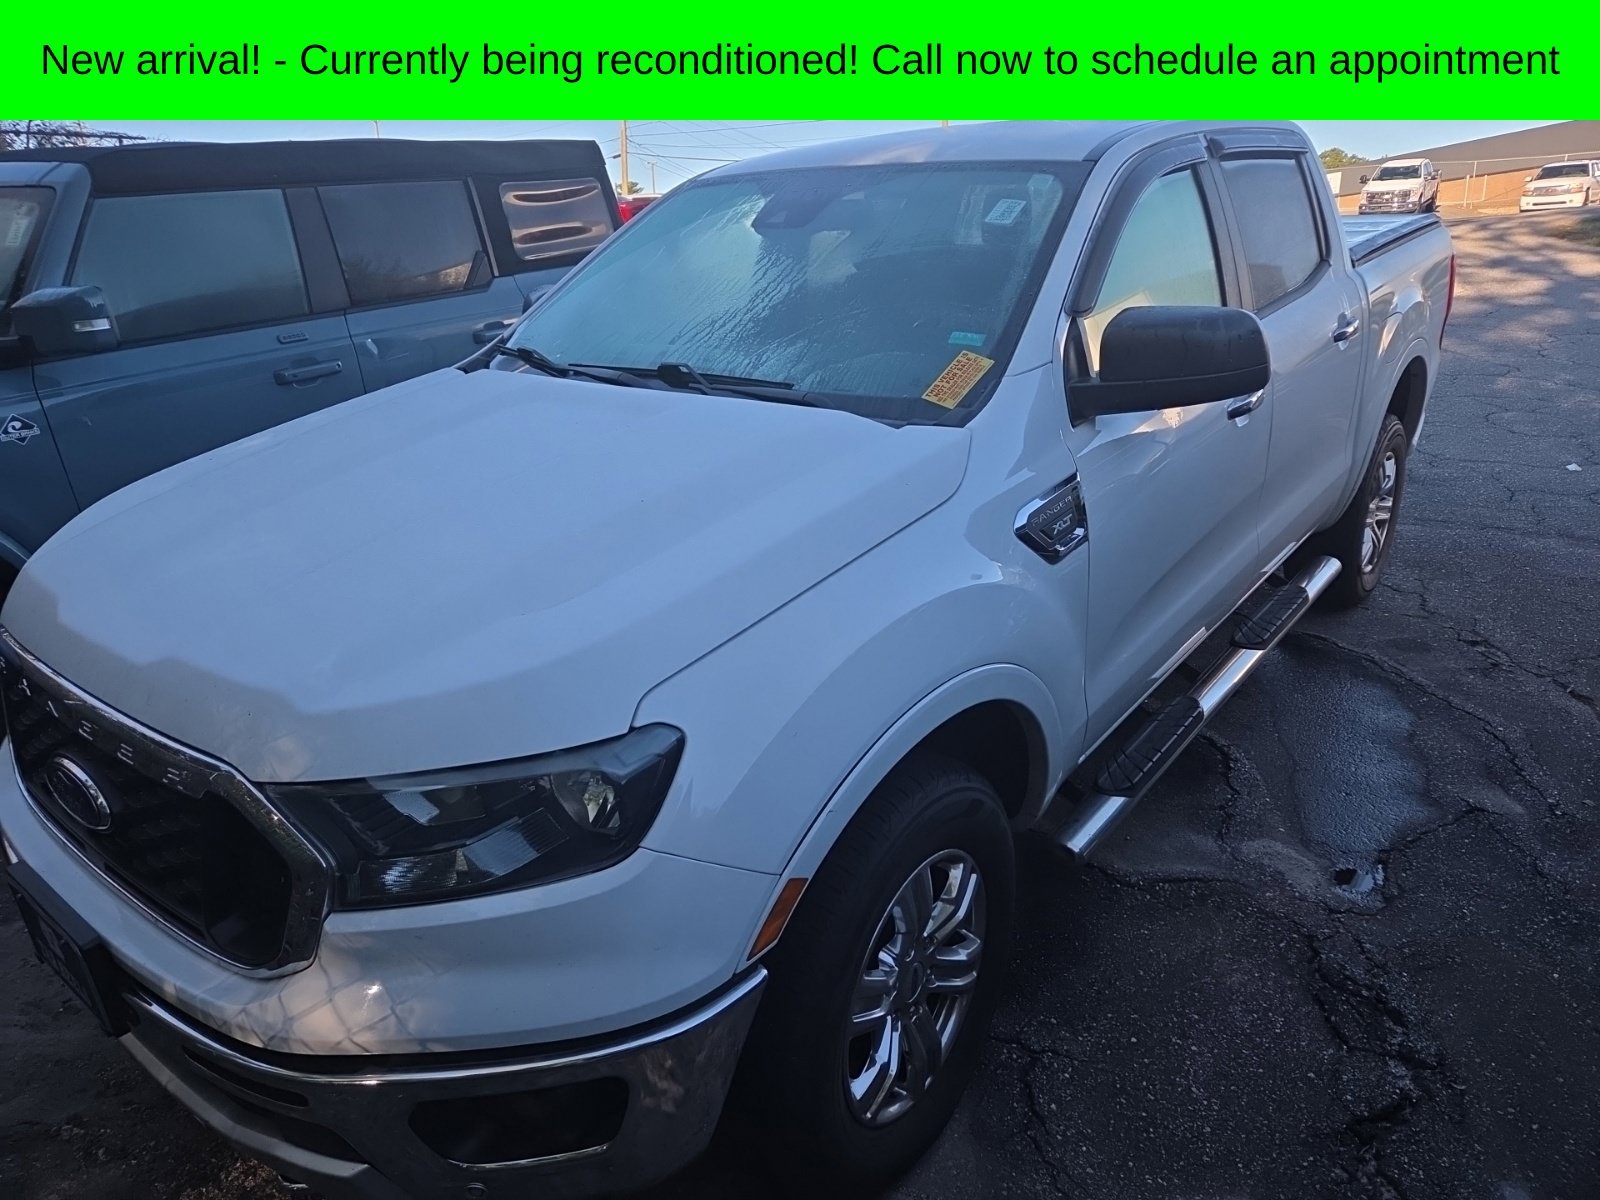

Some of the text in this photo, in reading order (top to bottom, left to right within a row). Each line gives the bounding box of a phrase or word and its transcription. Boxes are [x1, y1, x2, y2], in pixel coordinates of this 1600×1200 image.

[925, 383, 941, 397] THIS
[938, 358, 963, 383] VEHICLE
[933, 356, 973, 398] NOT FOR SALE
[1032, 495, 1072, 526] RANGER
[1052, 513, 1073, 535] XLT
